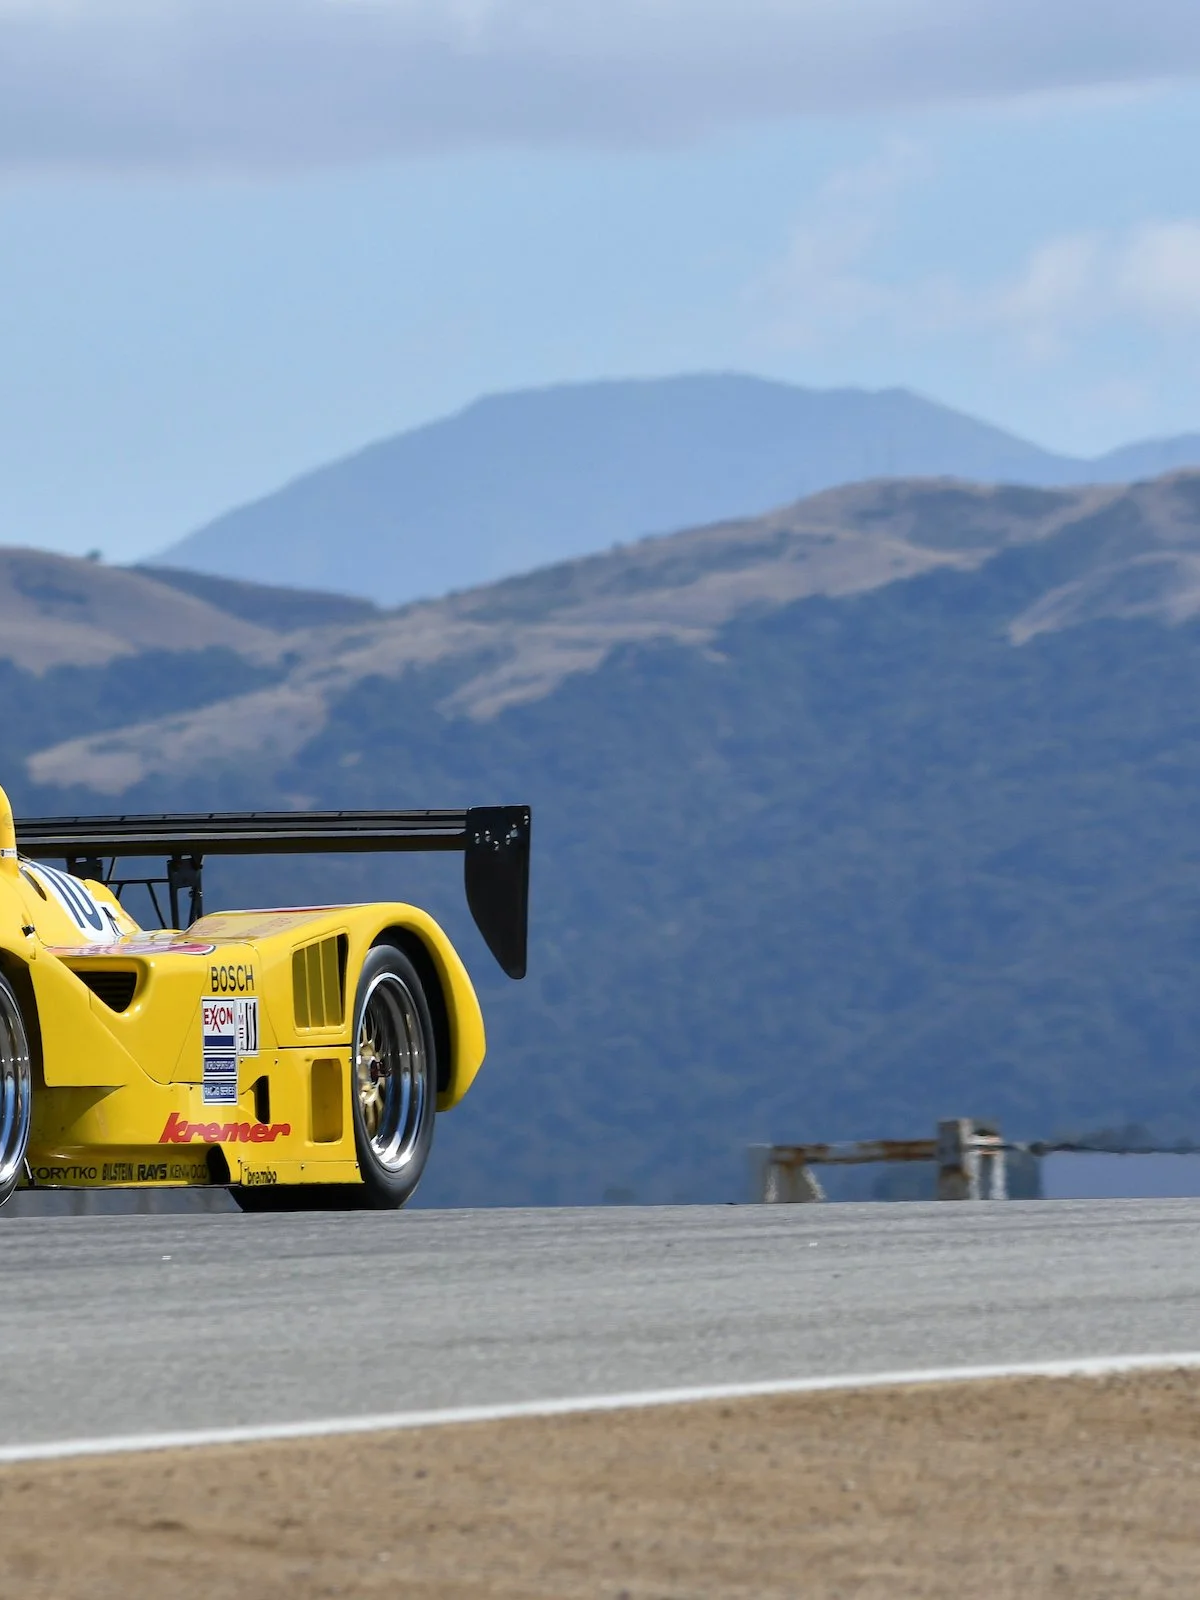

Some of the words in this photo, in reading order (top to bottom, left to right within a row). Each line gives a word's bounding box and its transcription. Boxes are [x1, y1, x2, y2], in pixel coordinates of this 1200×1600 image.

[211, 964, 255, 992] BOSCH
[203, 1004, 234, 1033] EXXON
[158, 1112, 291, 1144] kremer
[102, 1163, 133, 1181] BILSTEIN
[137, 1164, 168, 1180] RAYS
[247, 1166, 277, 1184] brembo
